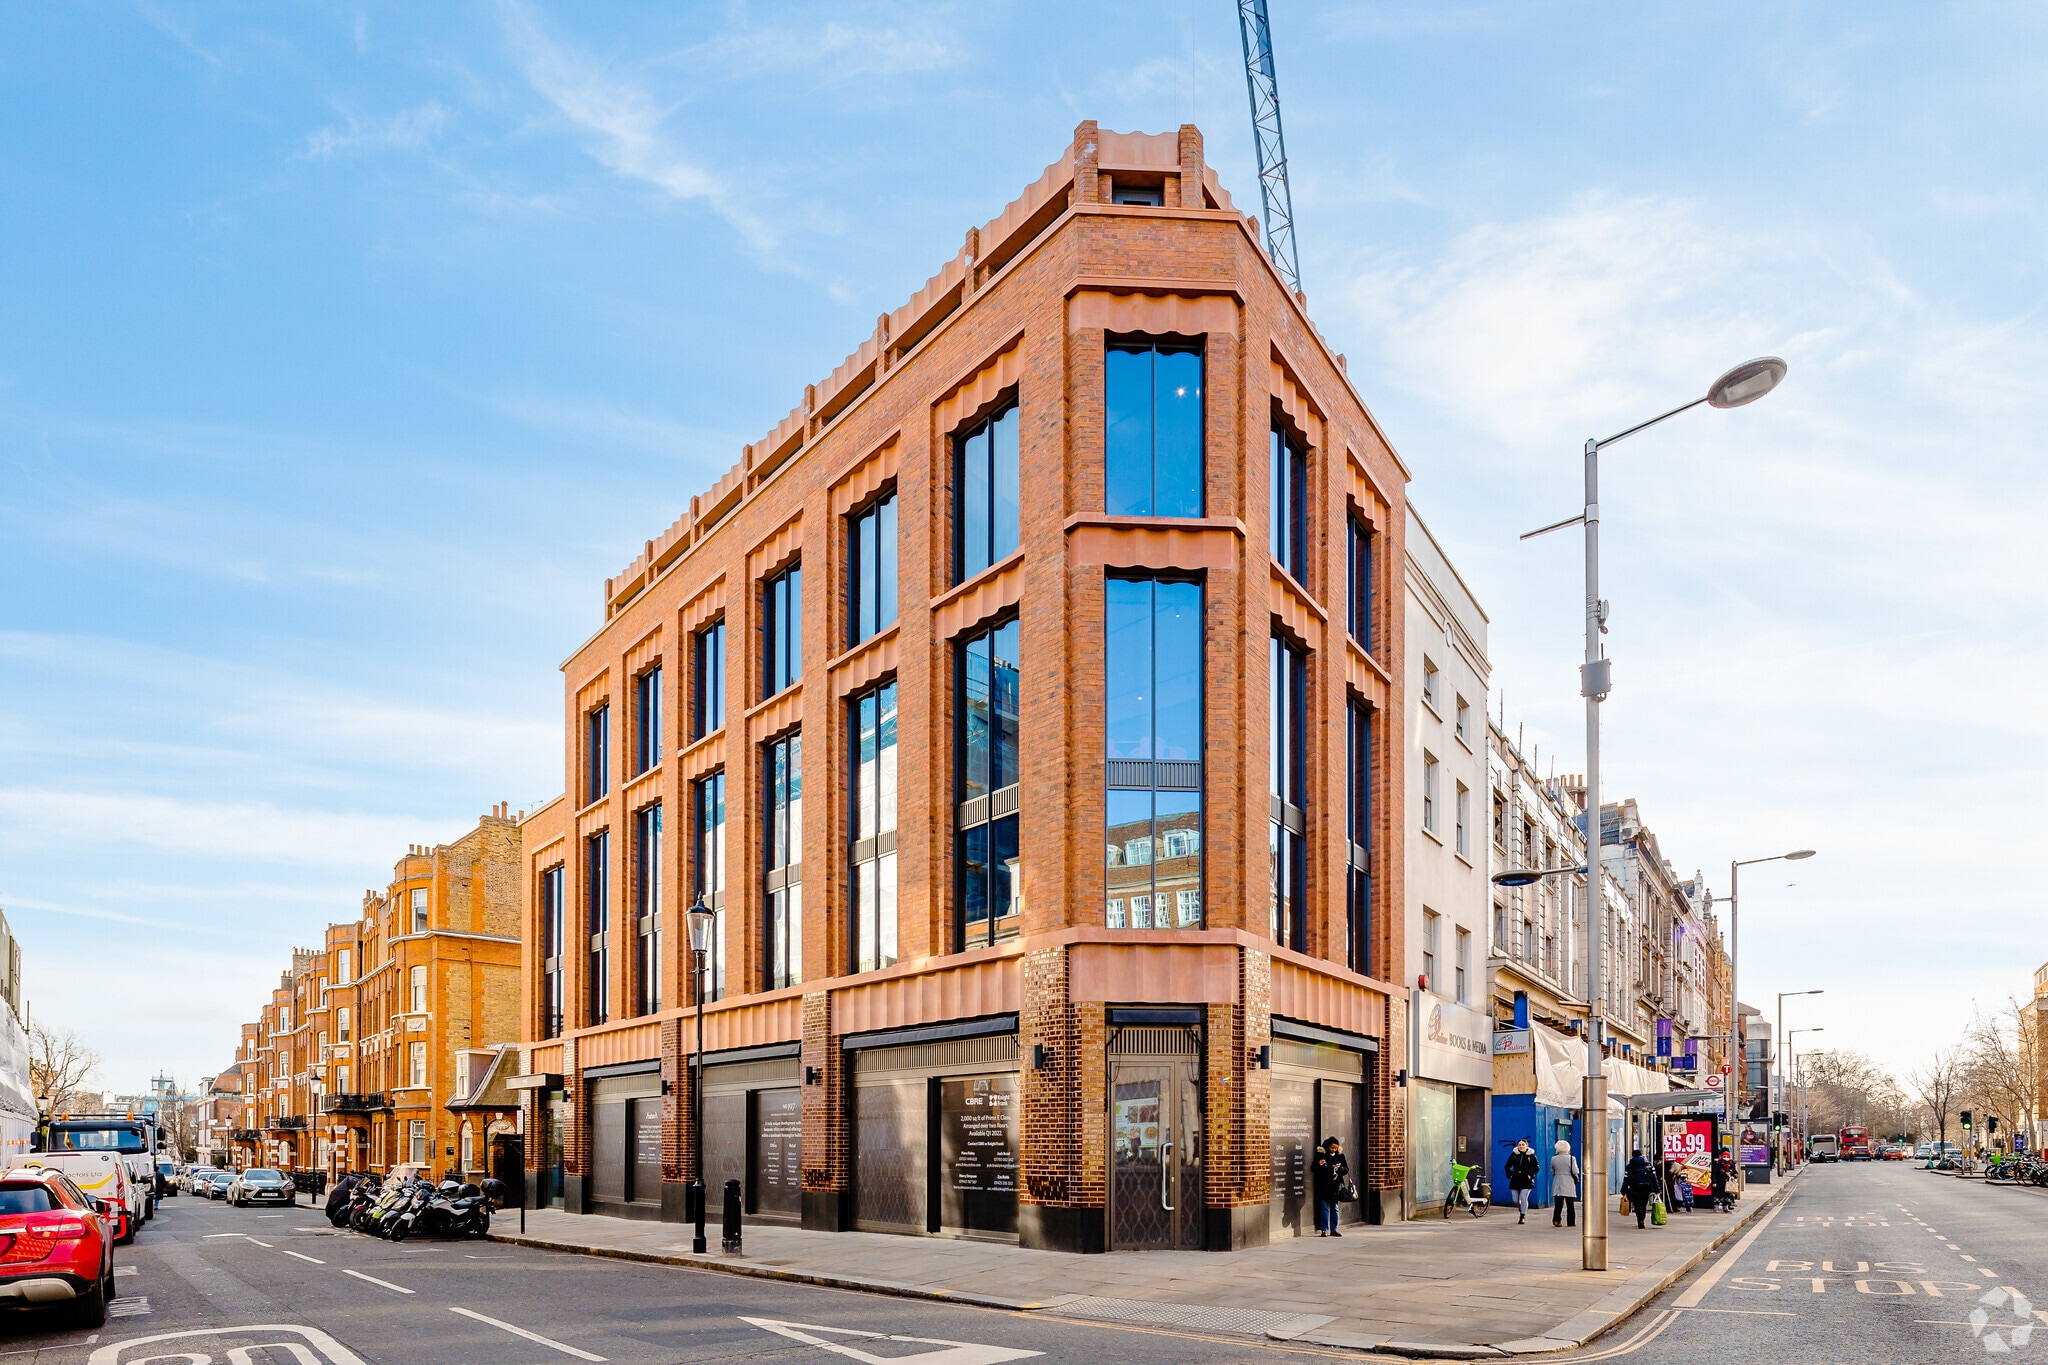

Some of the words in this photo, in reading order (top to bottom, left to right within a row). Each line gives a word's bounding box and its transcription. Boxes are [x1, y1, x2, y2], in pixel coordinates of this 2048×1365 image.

[1449, 1033, 1466, 1050] BOOKS
[1472, 1040, 1487, 1055] MEDIA
[1502, 1040, 1526, 1051] Pauline
[965, 1097, 983, 1105] CBRE
[1664, 1134, 1705, 1152] £6.99
[1765, 1259, 1928, 1275] BUS
[1727, 1276, 1982, 1297] STOP
